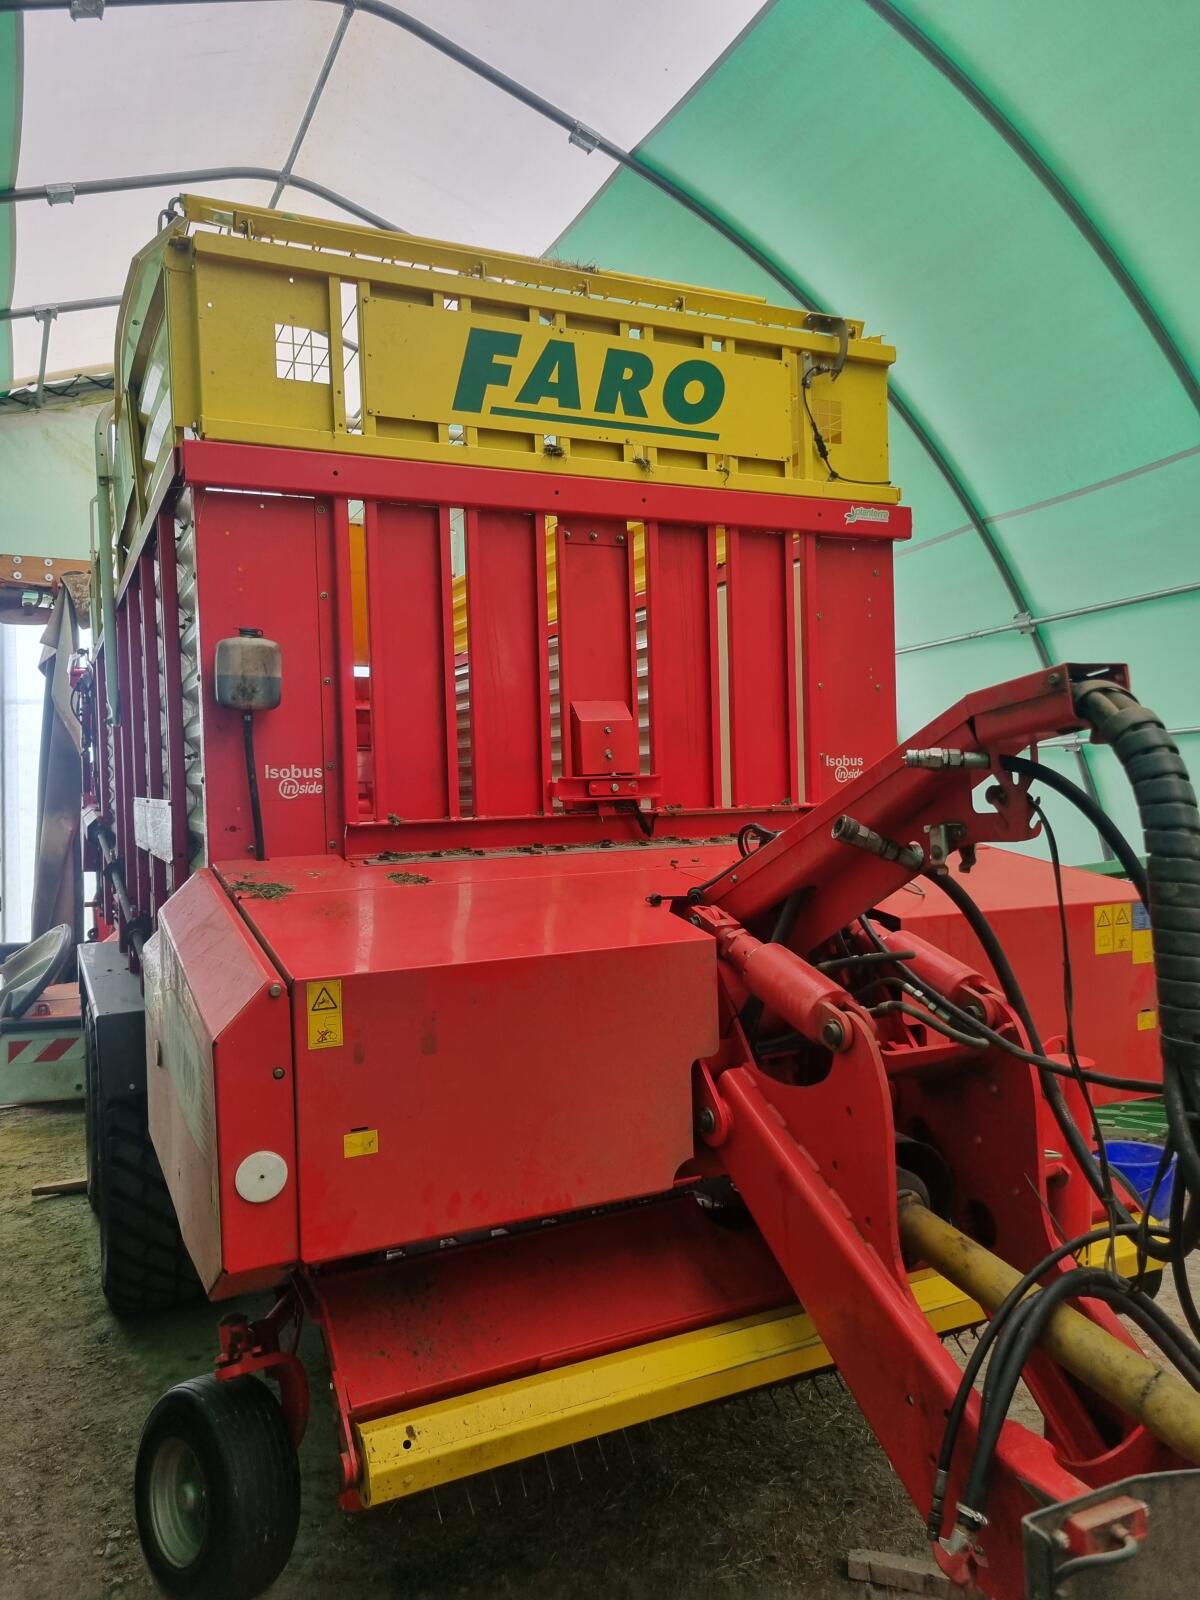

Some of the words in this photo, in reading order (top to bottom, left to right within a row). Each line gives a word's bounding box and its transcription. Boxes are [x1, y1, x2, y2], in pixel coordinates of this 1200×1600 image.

[452, 327, 725, 425] FARO
[826, 755, 864, 766] Isobus
[265, 764, 323, 779] Isobus
[279, 778, 323, 799] inside
